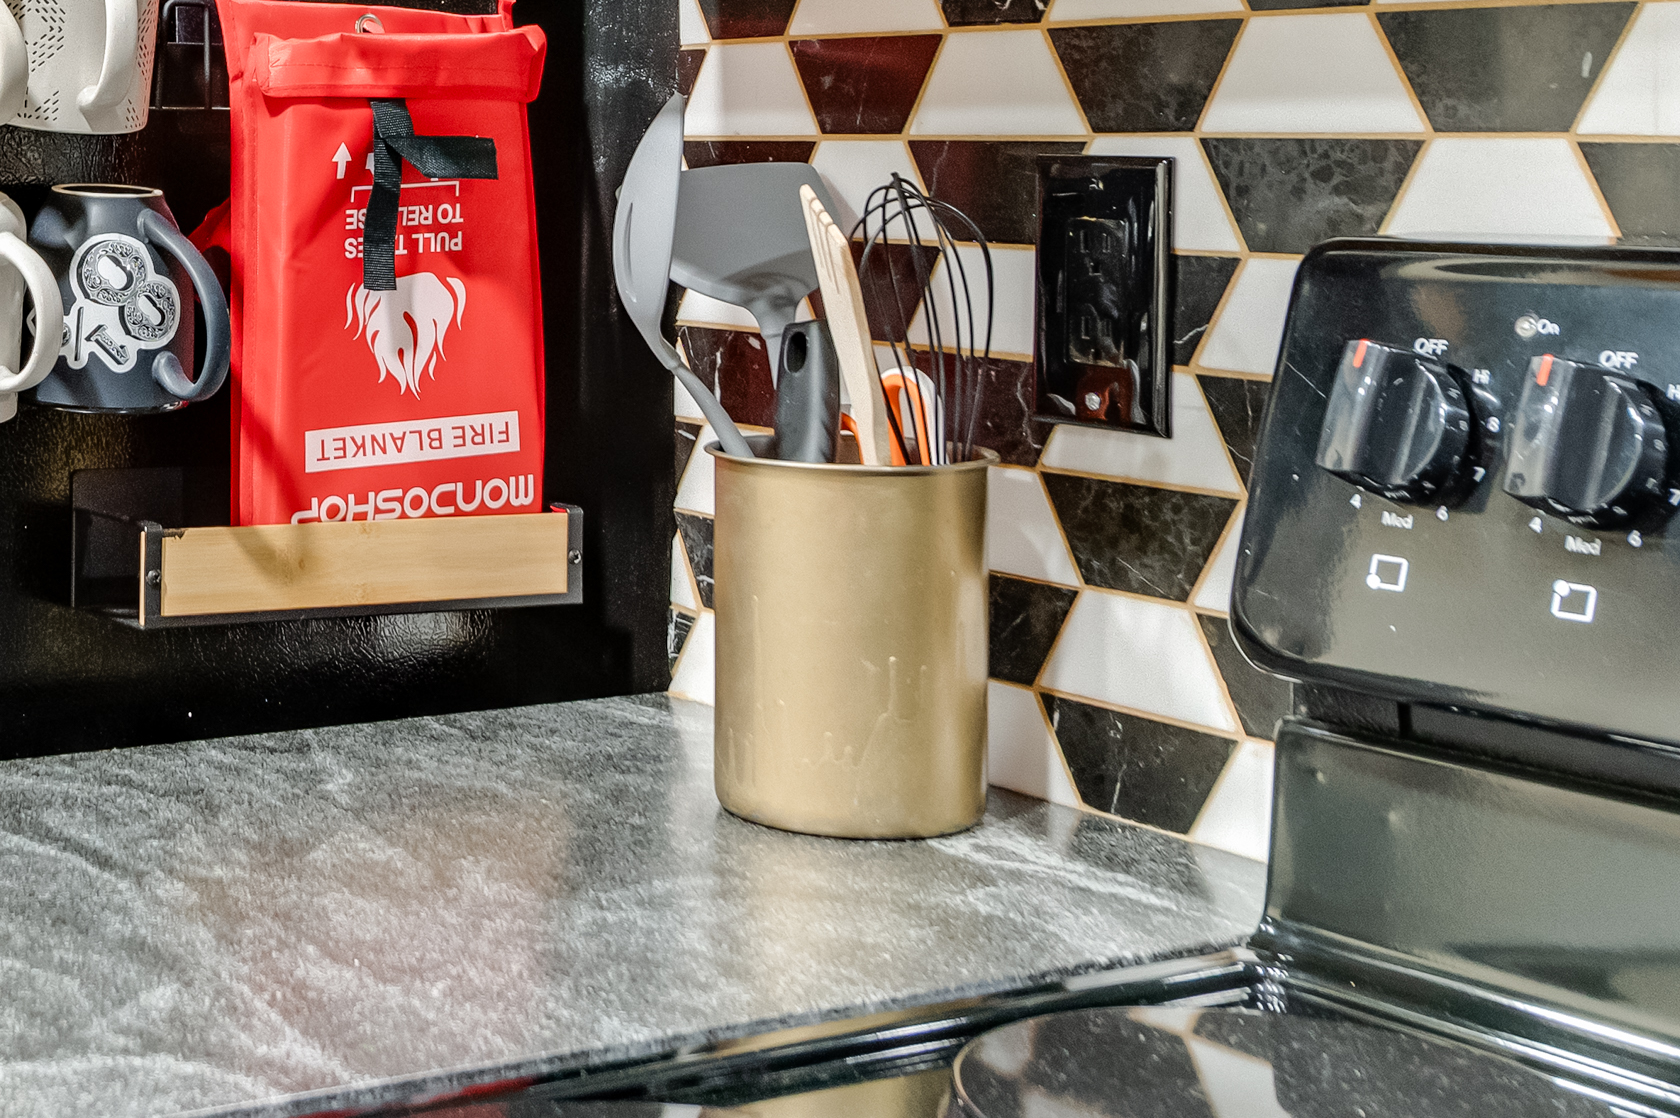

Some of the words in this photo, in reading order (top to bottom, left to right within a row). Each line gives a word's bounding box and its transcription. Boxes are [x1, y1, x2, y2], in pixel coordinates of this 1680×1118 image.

[345, 204, 433, 230] RELSE
[436, 203, 464, 224] TO
[411, 230, 463, 254] PULL
[1536, 318, 1561, 336] On
[1413, 337, 1449, 356] OFF
[1599, 350, 1639, 369] OFF
[451, 420, 510, 448] FIRE
[316, 427, 443, 462] BLANKET
[1473, 466, 1486, 482] 7
[1349, 493, 1362, 510] 4
[1380, 510, 1414, 530] Med
[1436, 505, 1449, 522] 6
[1528, 516, 1543, 534] 4
[1564, 534, 1602, 556] Med
[1627, 529, 1643, 548] 6
